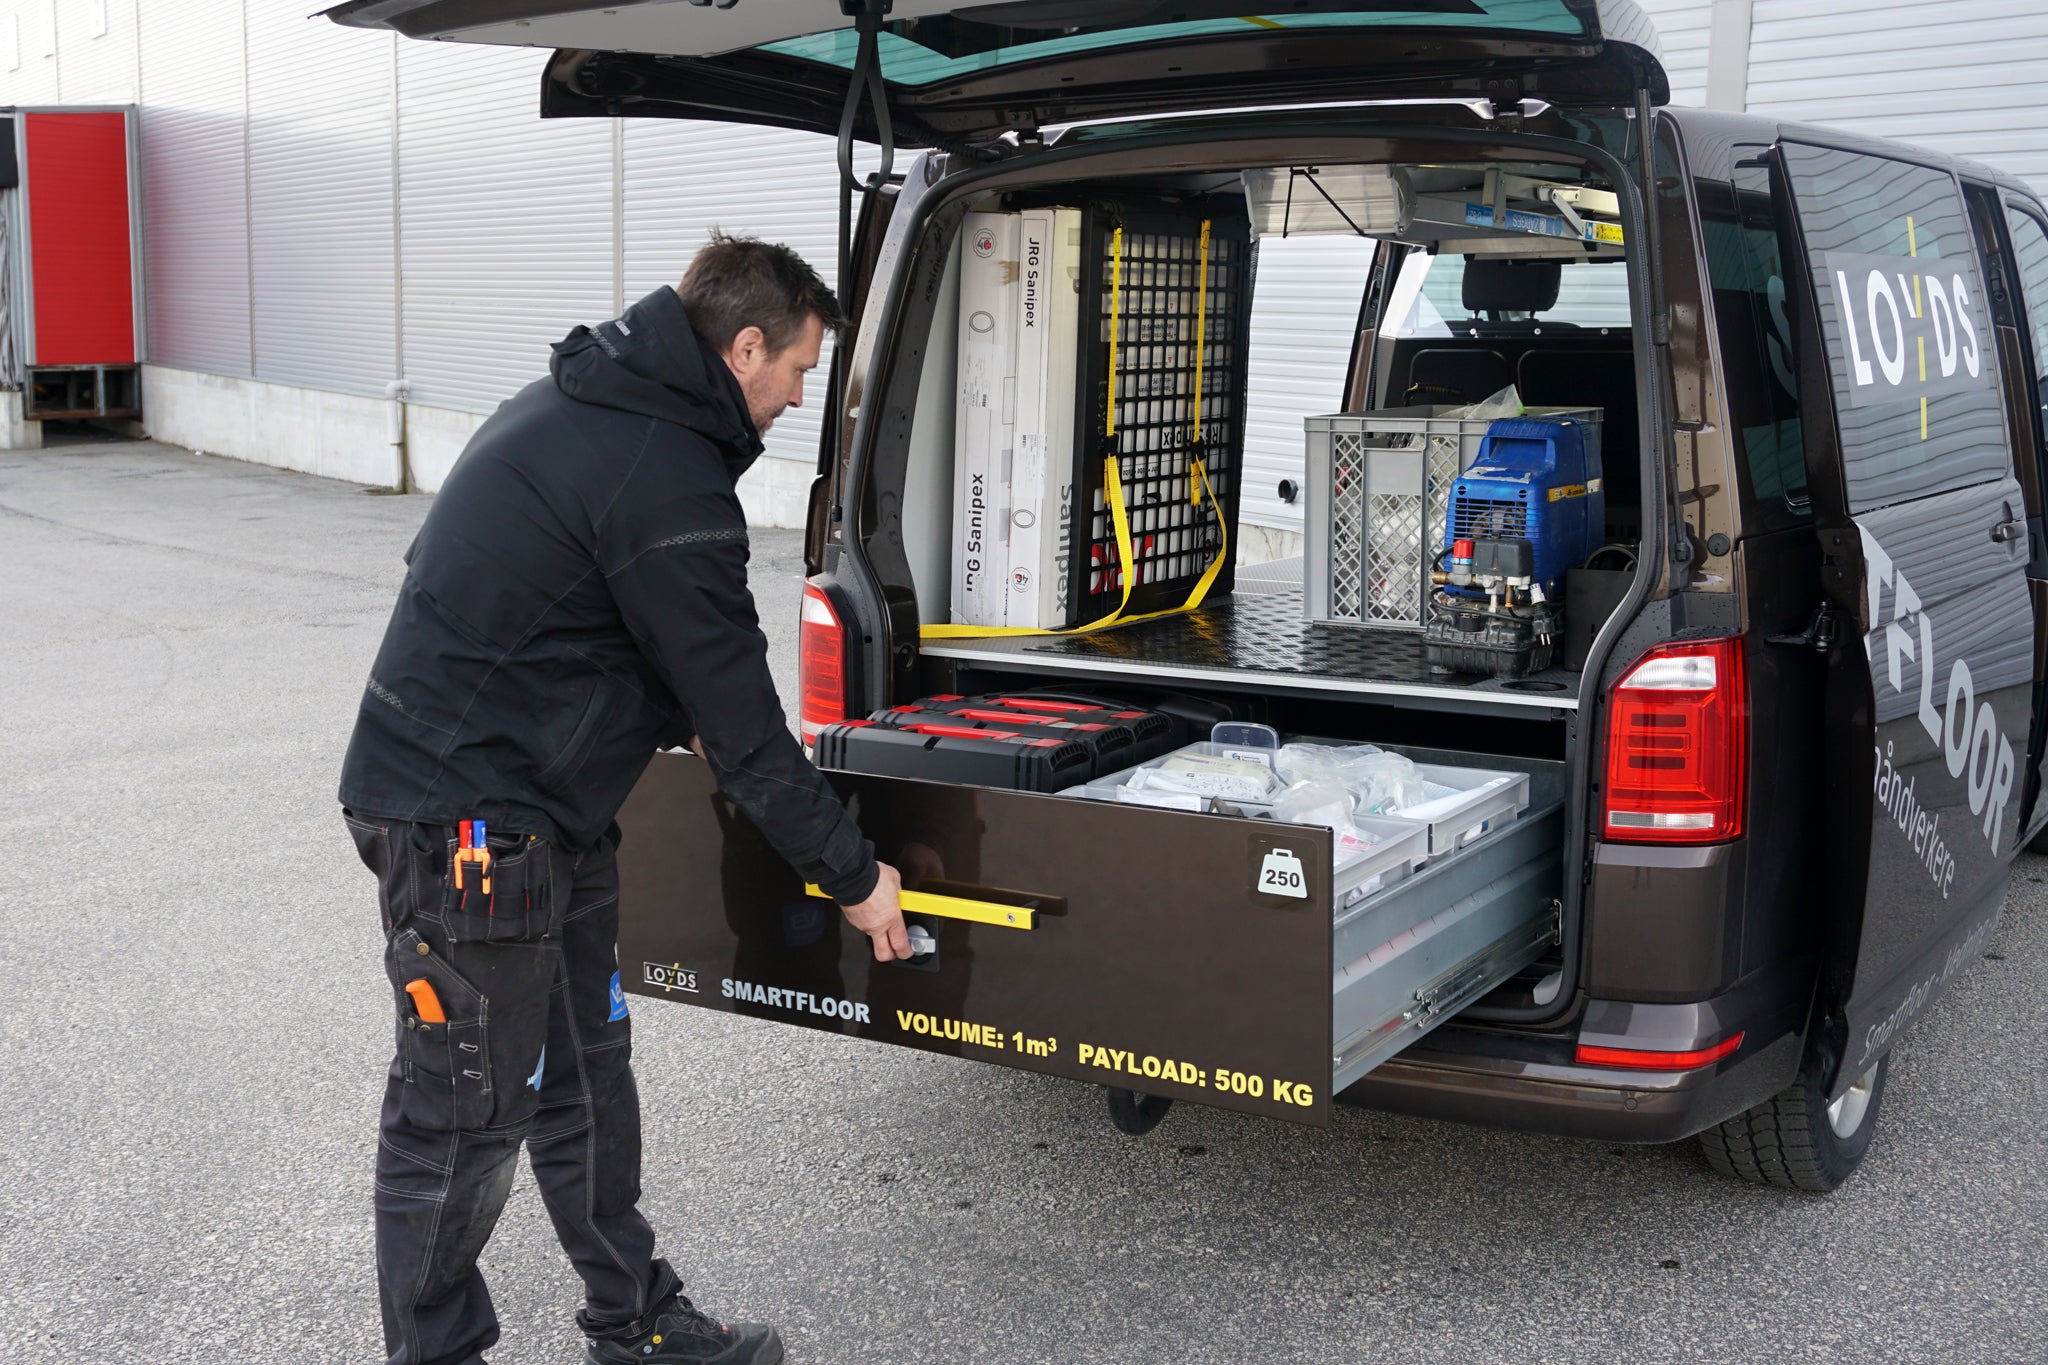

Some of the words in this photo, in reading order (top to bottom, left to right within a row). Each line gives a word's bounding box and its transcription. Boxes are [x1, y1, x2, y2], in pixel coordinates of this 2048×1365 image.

[1512, 213, 1539, 232] ZARGES
[1027, 236, 1039, 266] JRG
[1023, 270, 1039, 329] Sanipex
[1836, 268, 1981, 387] LOYDS
[967, 473, 984, 552] Sanipex
[1265, 867, 1301, 888] 250
[646, 965, 697, 989] LOYDS
[721, 978, 870, 1025] SMARTFLOOR
[1858, 972, 1937, 1066] Smartfloor
[897, 1010, 1004, 1050] VOLUME:
[1078, 1043, 1206, 1088] PAYLOAD:
[1214, 1069, 1263, 1099] 500
[1273, 1079, 1313, 1107] KG
